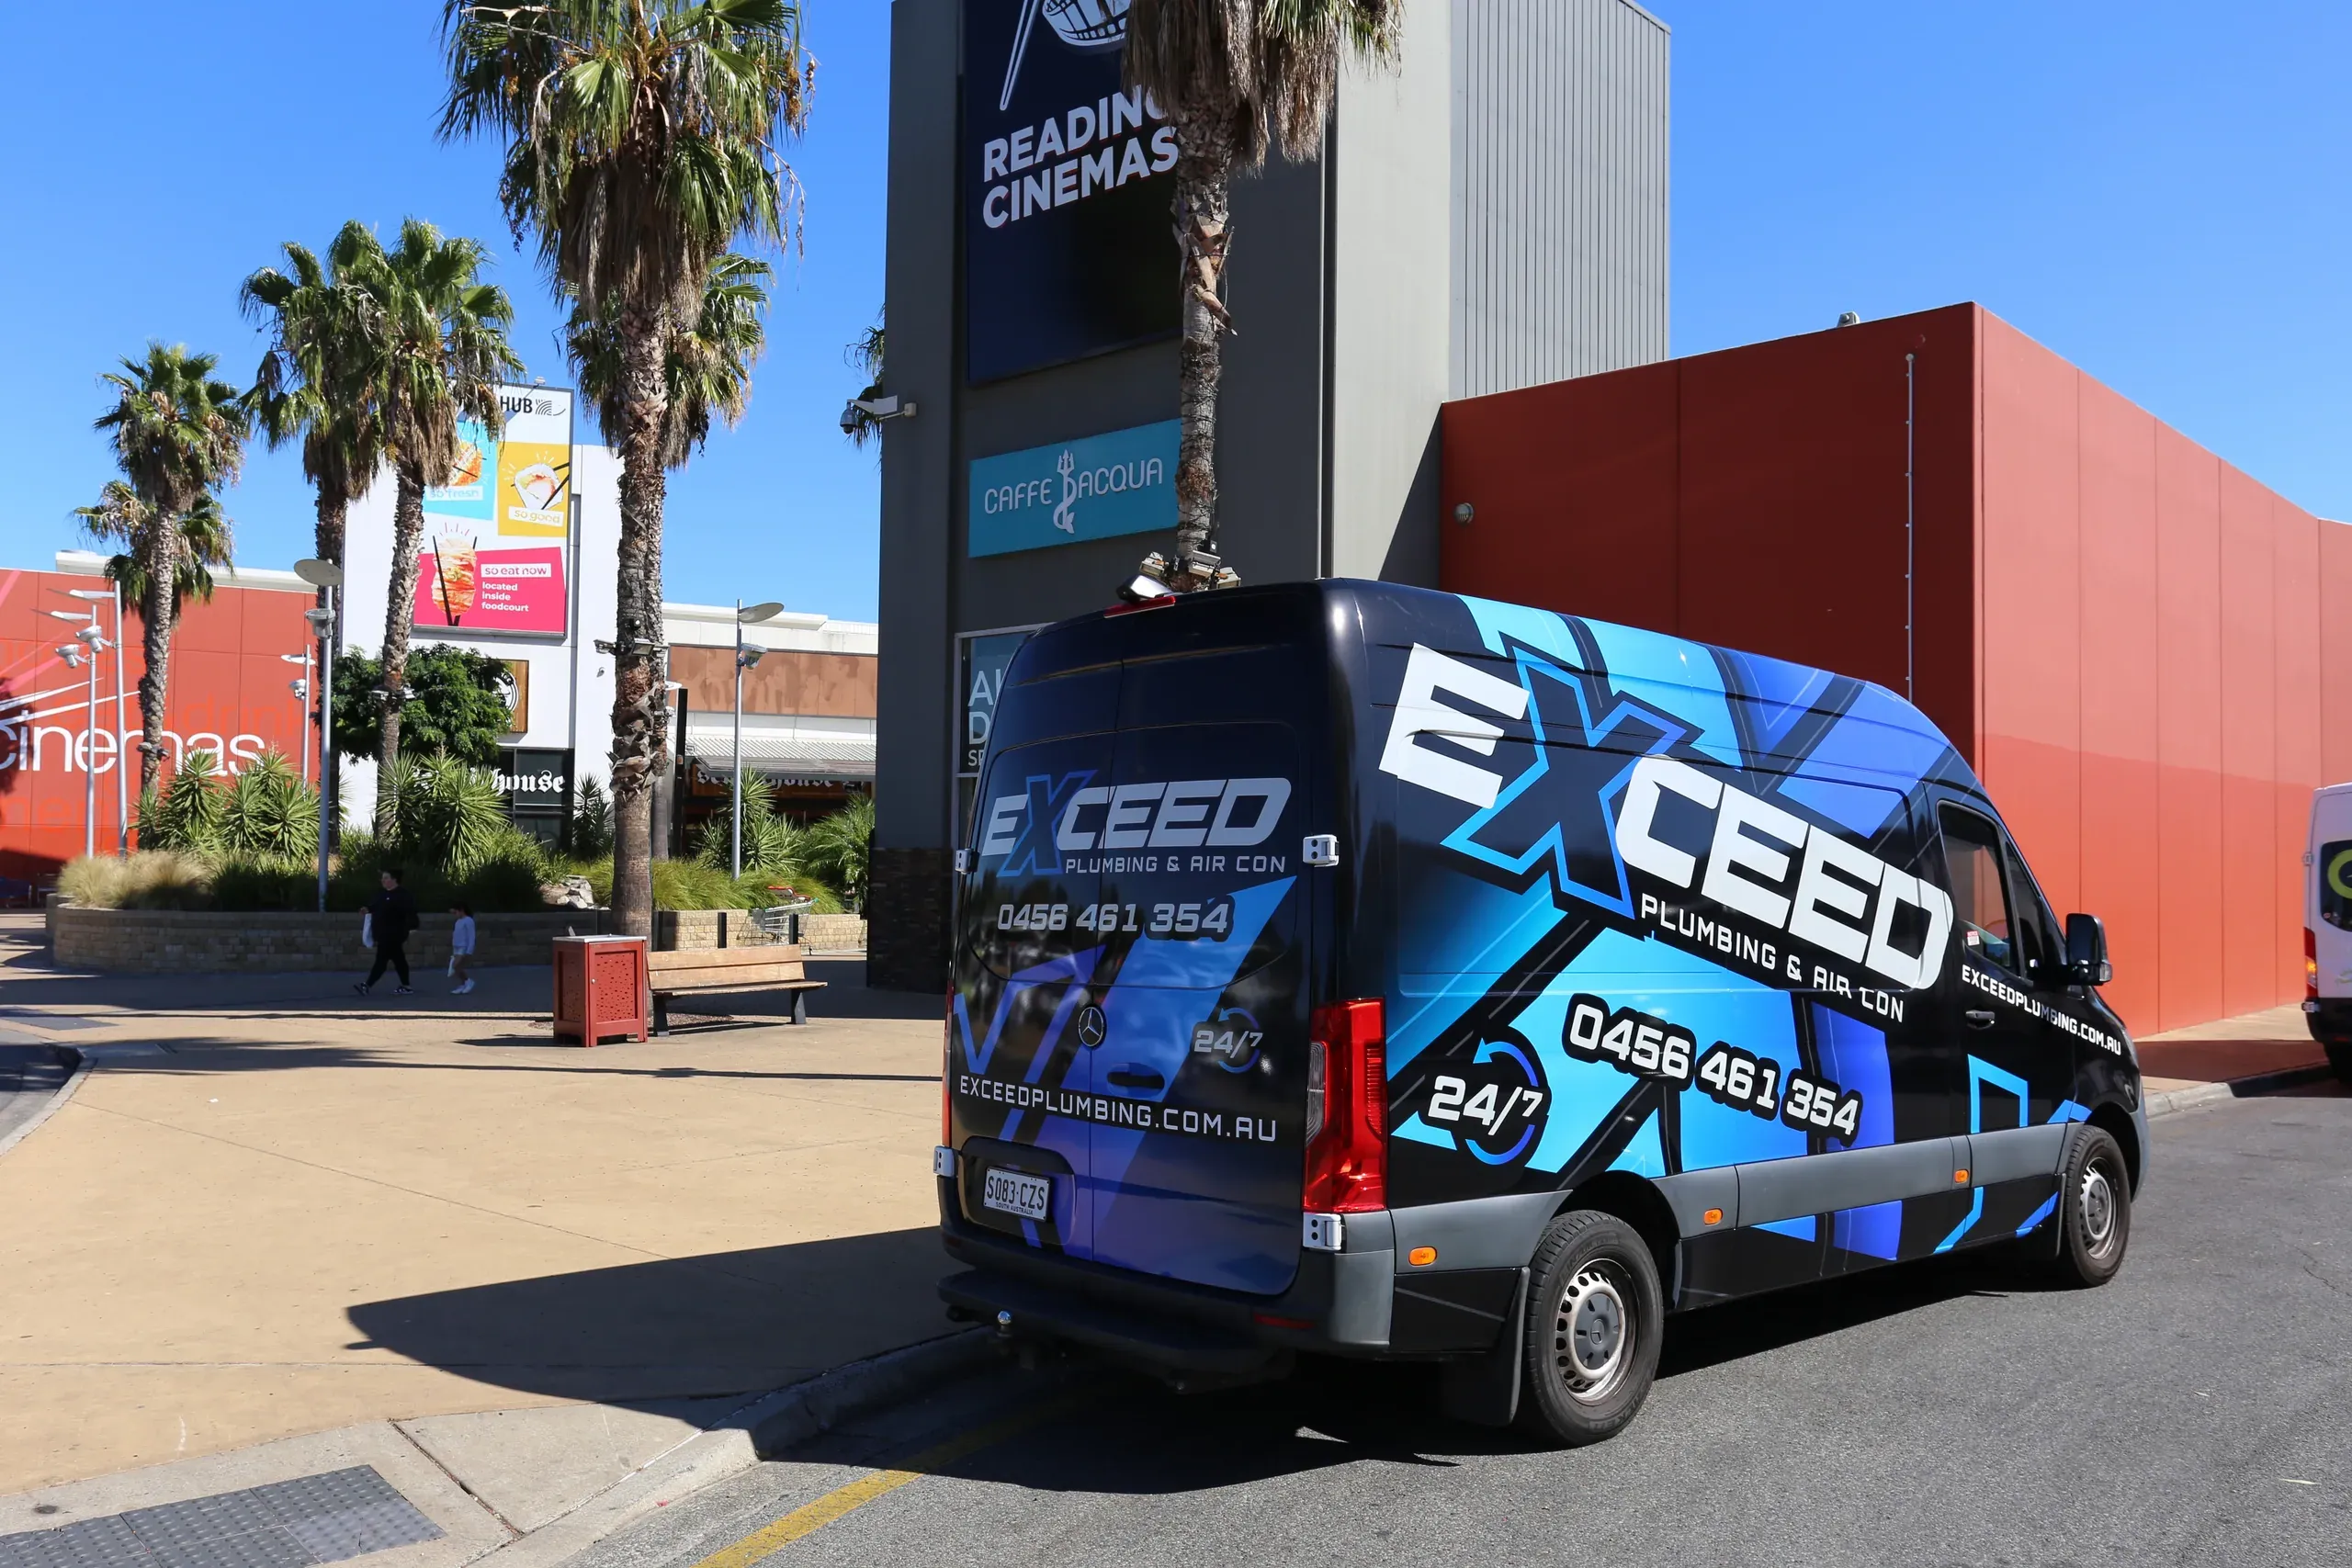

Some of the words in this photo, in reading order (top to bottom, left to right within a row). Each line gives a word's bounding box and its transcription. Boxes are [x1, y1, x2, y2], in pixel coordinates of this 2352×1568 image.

[983, 126, 1179, 229] CINEMAS
[500, 396, 533, 413] HUB
[1078, 457, 1163, 499] ACQUA
[514, 510, 528, 519] so
[529, 512, 560, 524] good
[484, 567, 499, 575] so
[501, 567, 520, 575] eat
[522, 567, 547, 575] now
[481, 591, 511, 601] inside
[482, 581, 518, 592] located
[481, 601, 529, 612] foodcourt
[981, 770, 1292, 877] EXCEED
[1379, 642, 1954, 989] EXCEED
[1066, 856, 1158, 874] PLUMBING
[1167, 856, 1180, 872] &
[1190, 855, 1226, 872] AIR
[1236, 855, 1286, 873] CON
[997, 904, 1068, 931] 0456
[1075, 904, 1138, 931] 461
[1149, 904, 1230, 933] 354
[1641, 894, 1776, 972] PLUMBING
[1786, 956, 1803, 982] &
[1813, 964, 1852, 999] AIR
[1859, 986, 1904, 1023] CON
[1962, 964, 2121, 1055] EXCEEDPLUMBING.COM.AU
[1193, 1030, 1264, 1059] 24/7
[1569, 1003, 1691, 1081] 0456
[1701, 1051, 1776, 1110] 461
[1786, 1080, 1860, 1135] 354
[959, 1075, 1276, 1142] EXCEEDPLUMBING.COM.AU
[1428, 1076, 1544, 1135] 24/7
[995, 1201, 1010, 1210] SOUTH
[1011, 1205, 1034, 1215] AUSTRALIA
